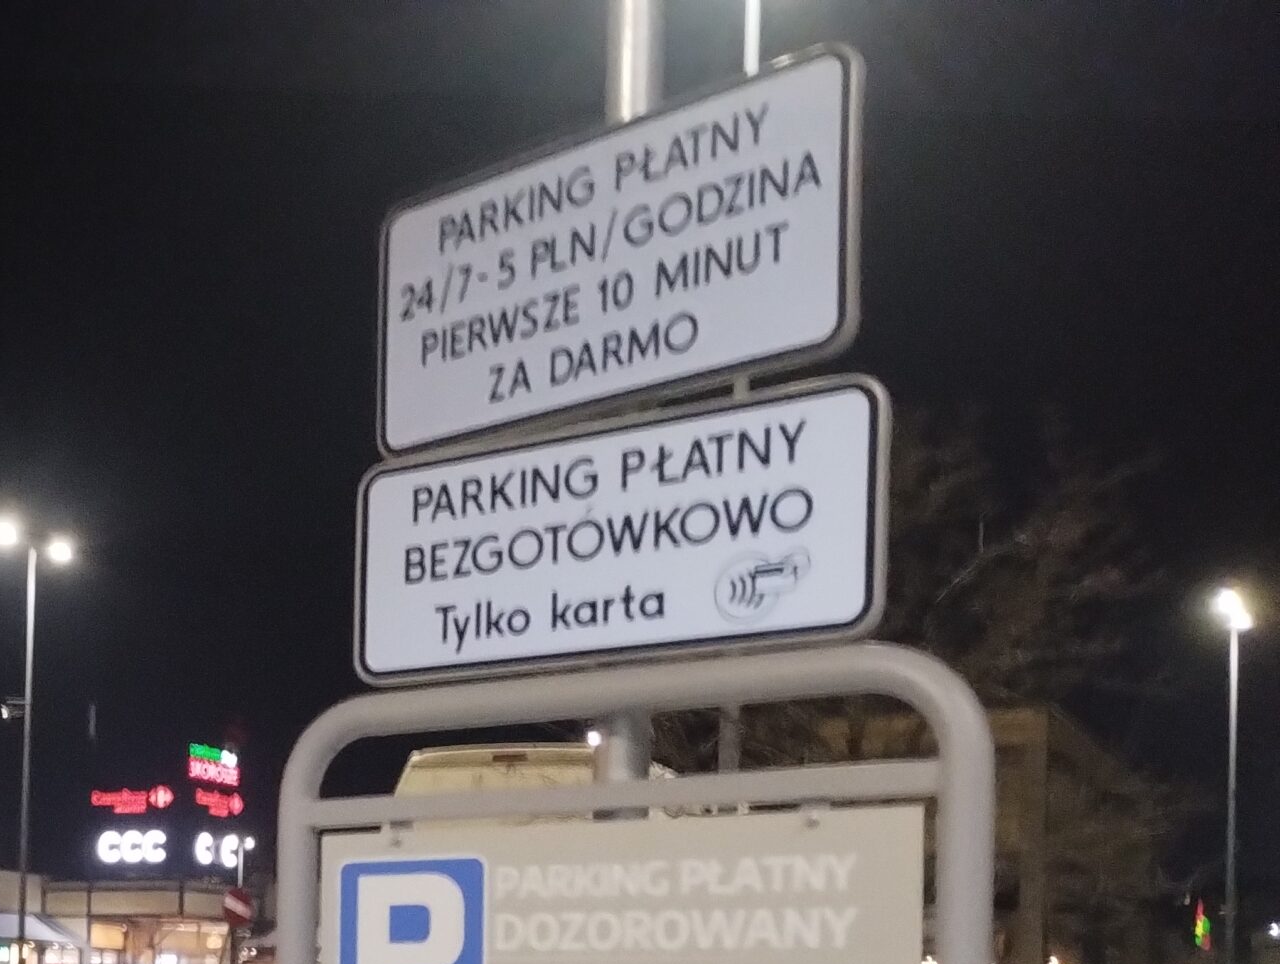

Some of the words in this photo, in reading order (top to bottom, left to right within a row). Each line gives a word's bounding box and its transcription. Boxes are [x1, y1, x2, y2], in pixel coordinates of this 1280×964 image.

[438, 165, 595, 255] PARKING
[614, 102, 770, 192] PŁATNY
[530, 150, 821, 281] PLN/GODZINA
[421, 283, 581, 368] PIERWSZE
[597, 271, 634, 314] 10
[655, 221, 789, 298] MINUT
[489, 357, 532, 404] ZA
[549, 312, 699, 387] DARMO
[412, 457, 599, 524] PARKING
[620, 419, 807, 491] PŁATNY
[405, 487, 813, 586] BEZGOTÓWKOWO
[435, 602, 531, 654] Tylko
[551, 584, 666, 632] karta
[98, 830, 168, 864] CCC
[494, 862, 670, 899] PARKING
[680, 851, 859, 897] PŁATNY
[494, 906, 859, 953] DOZOROWANY
